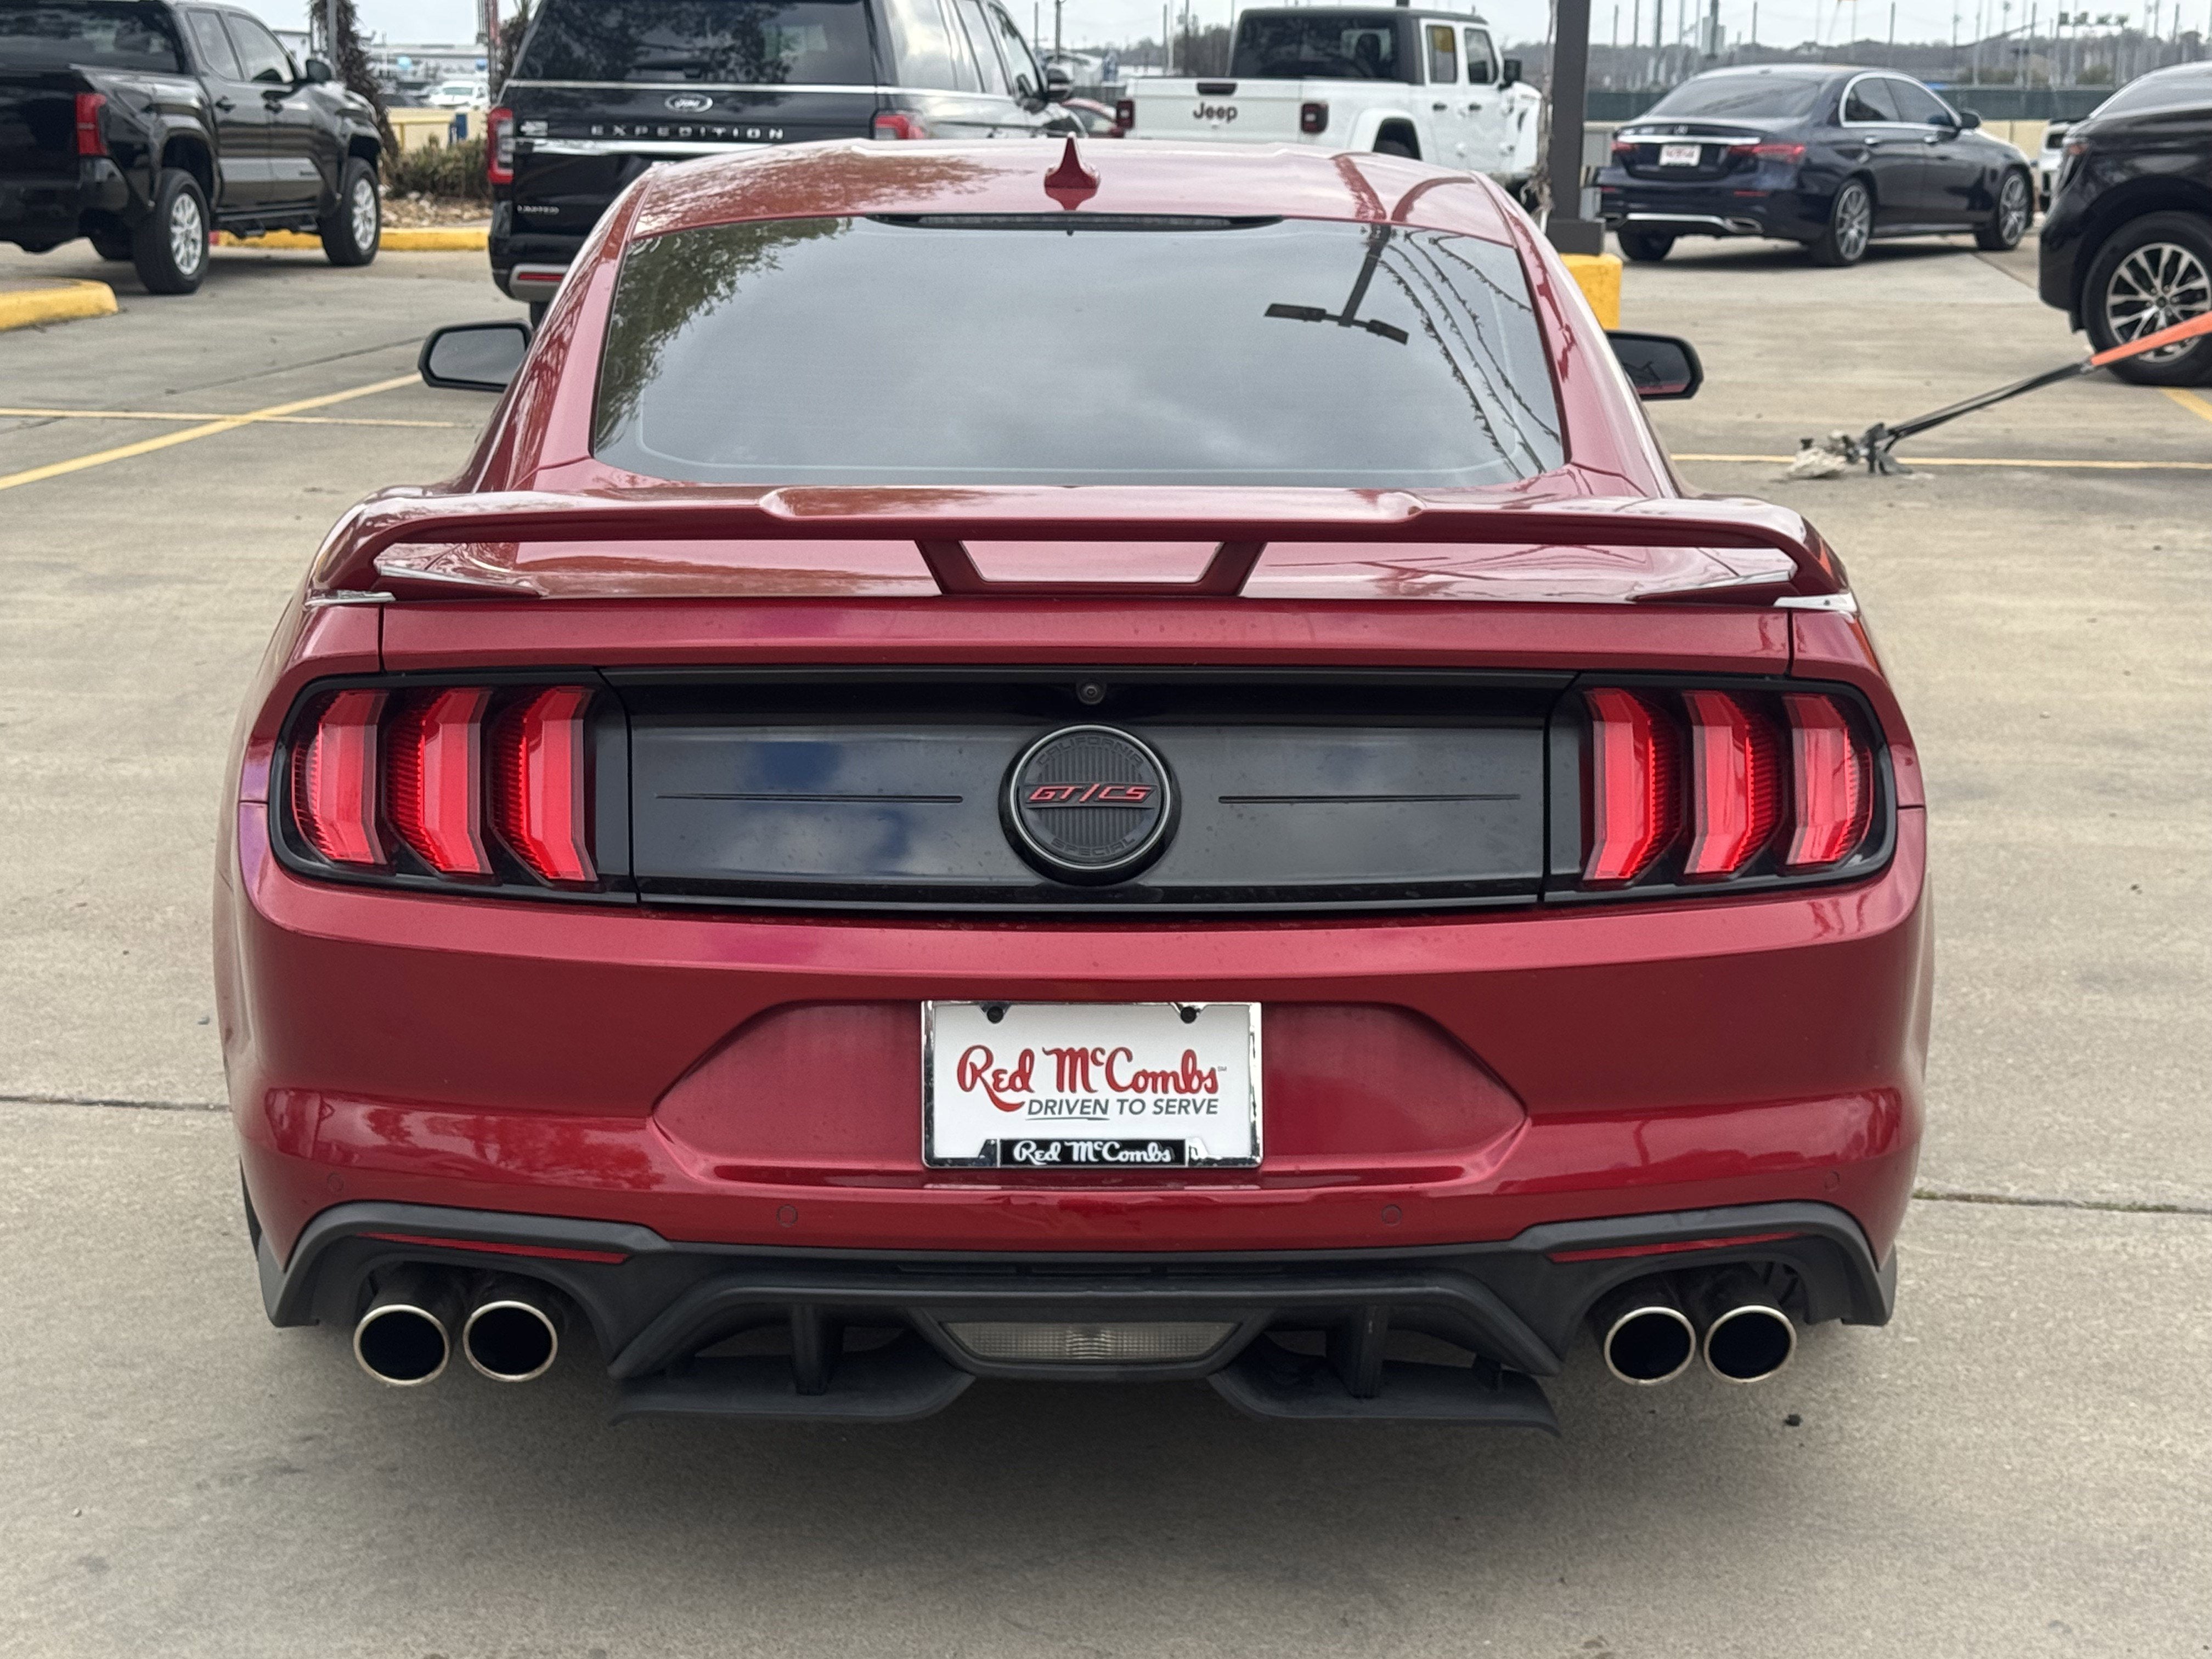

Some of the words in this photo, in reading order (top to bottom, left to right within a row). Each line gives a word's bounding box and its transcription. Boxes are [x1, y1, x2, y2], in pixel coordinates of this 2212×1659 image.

[1193, 101, 1238, 124] Jeep
[591, 124, 785, 140] EXPEDITION
[1036, 736, 1144, 766] CALIFORNIA
[1028, 783, 1153, 804] GT/CS
[1051, 838, 1135, 856] SPECIAL
[957, 1045, 1035, 1113] Red
[1042, 1046, 1219, 1094] McCombs
[1028, 1098, 1109, 1115] DRIVEN
[1116, 1098, 1146, 1115] TO
[1153, 1098, 1219, 1115] SERVE
[1013, 1140, 1062, 1165] Red
[1064, 1141, 1172, 1162] McCombs
